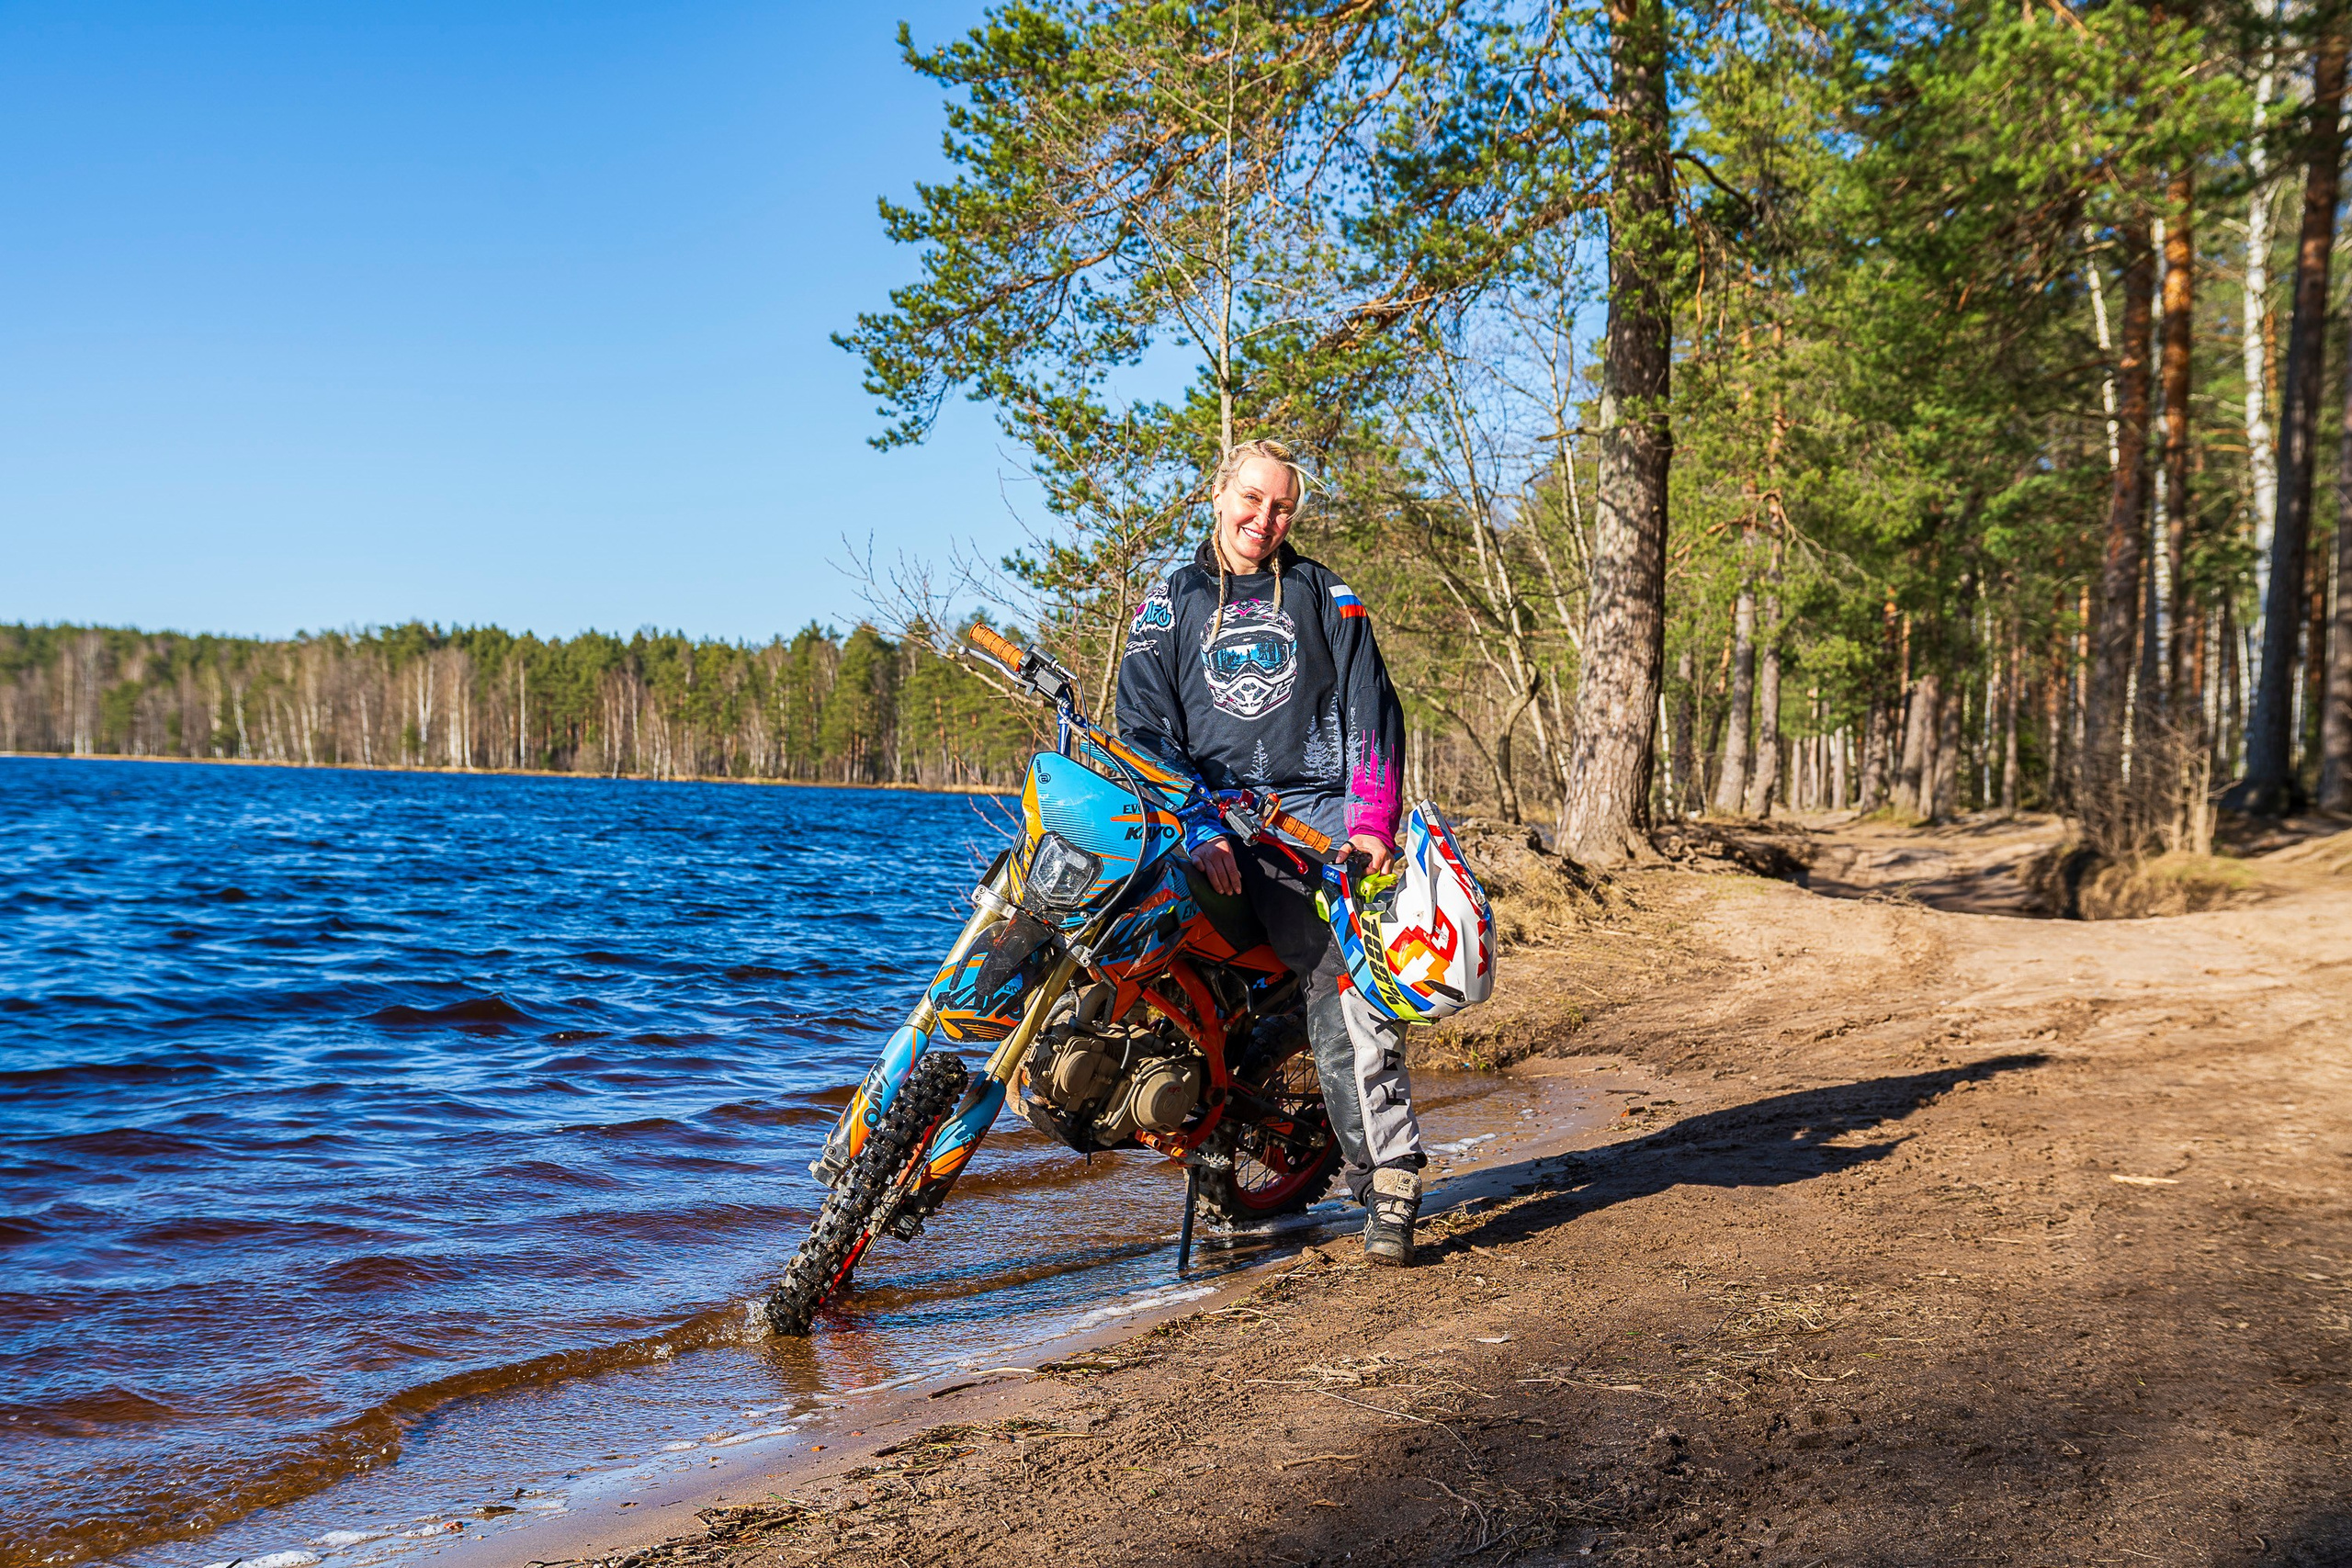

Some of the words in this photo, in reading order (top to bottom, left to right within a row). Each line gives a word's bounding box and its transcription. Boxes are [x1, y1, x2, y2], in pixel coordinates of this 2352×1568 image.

[1123, 804, 1150, 815] EVO
[1124, 825, 1176, 842] KAYO
[1361, 917, 1408, 1005] 100%
[1003, 985, 1020, 994] EVO
